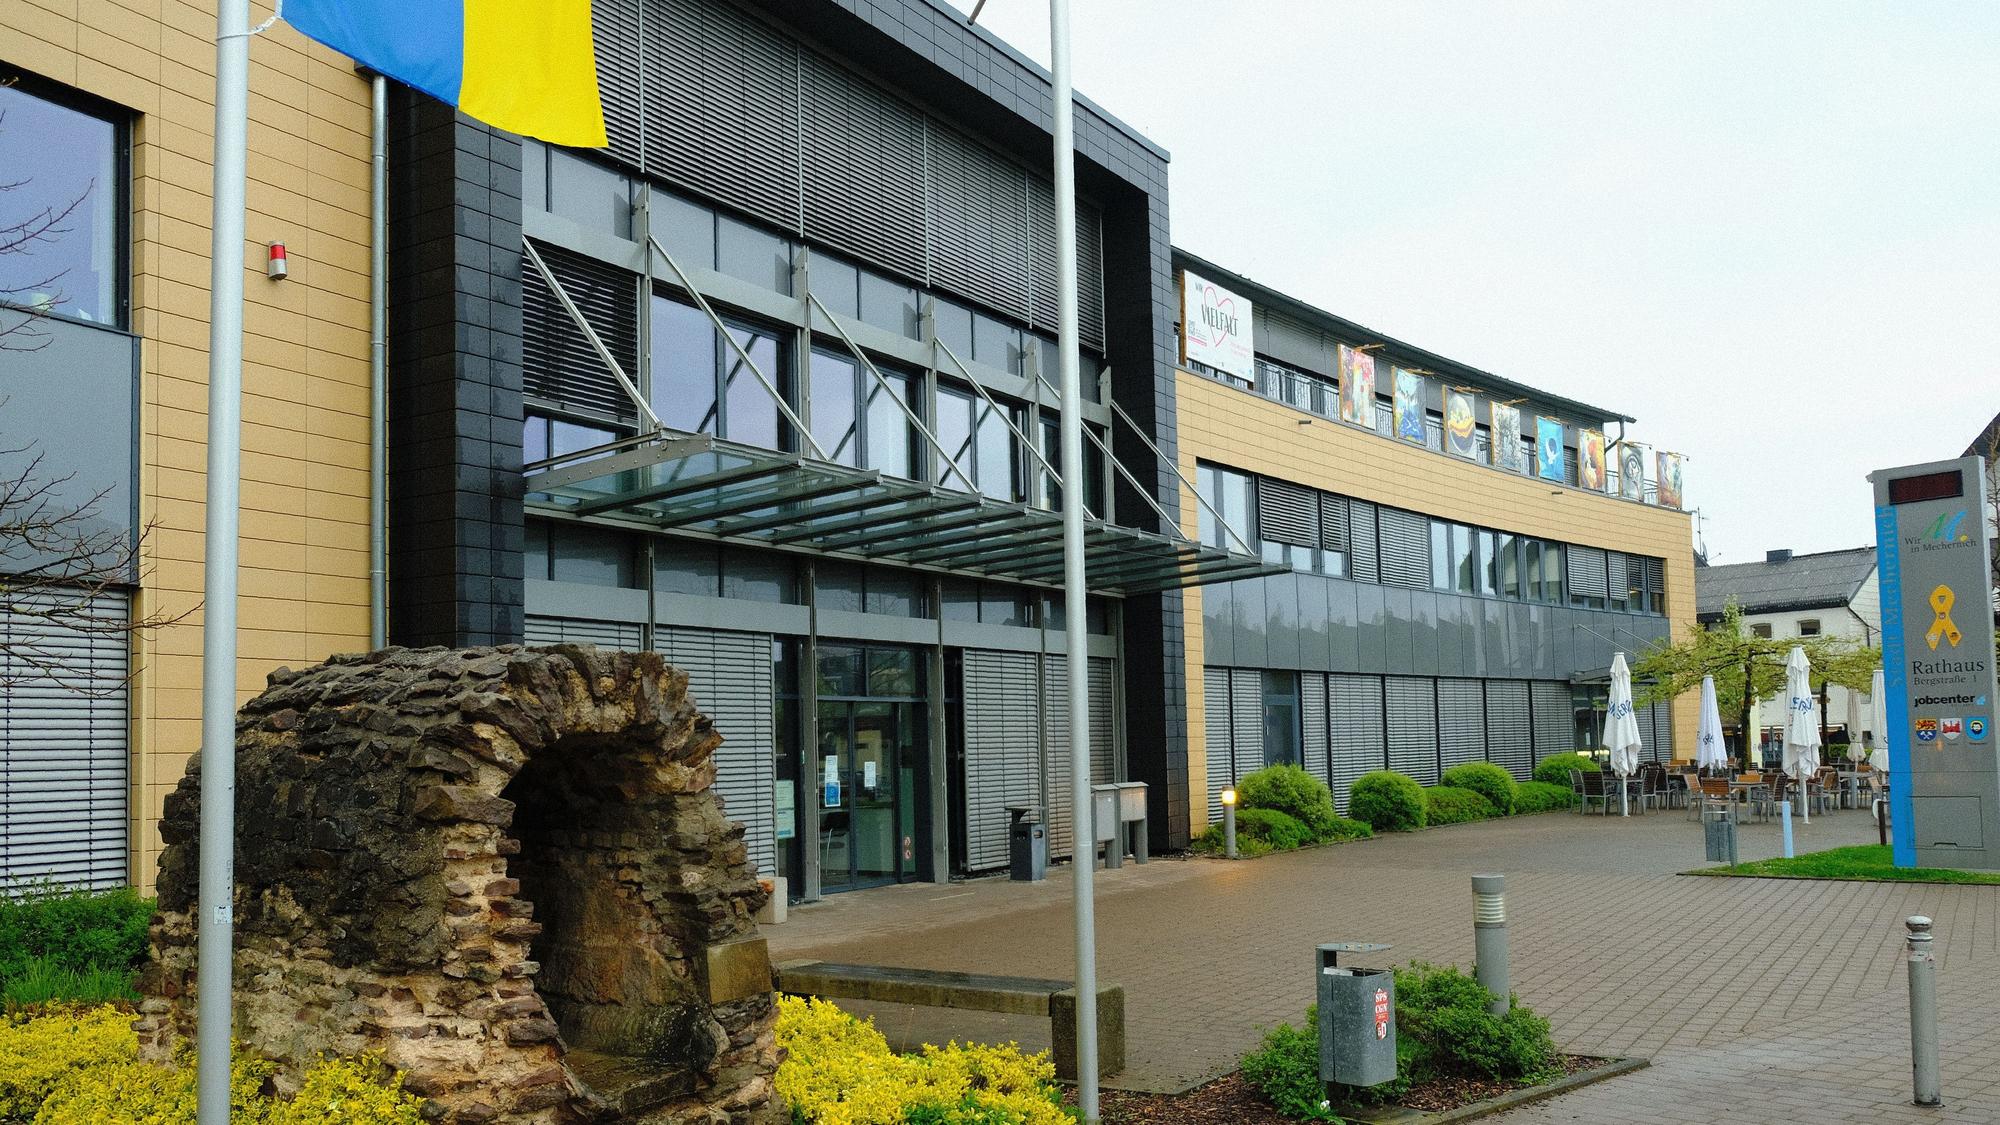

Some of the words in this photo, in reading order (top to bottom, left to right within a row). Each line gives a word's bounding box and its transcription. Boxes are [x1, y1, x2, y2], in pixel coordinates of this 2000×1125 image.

[1201, 303, 1239, 337] VIELFALT
[1904, 536, 1921, 546] Wir
[1878, 505, 1899, 626] Mechernich
[1888, 635, 1902, 688] Stadt
[1912, 659, 1985, 675] Rathaus
[1914, 675, 1967, 686] Bergstraße
[1914, 694, 1976, 708] jobcenter
